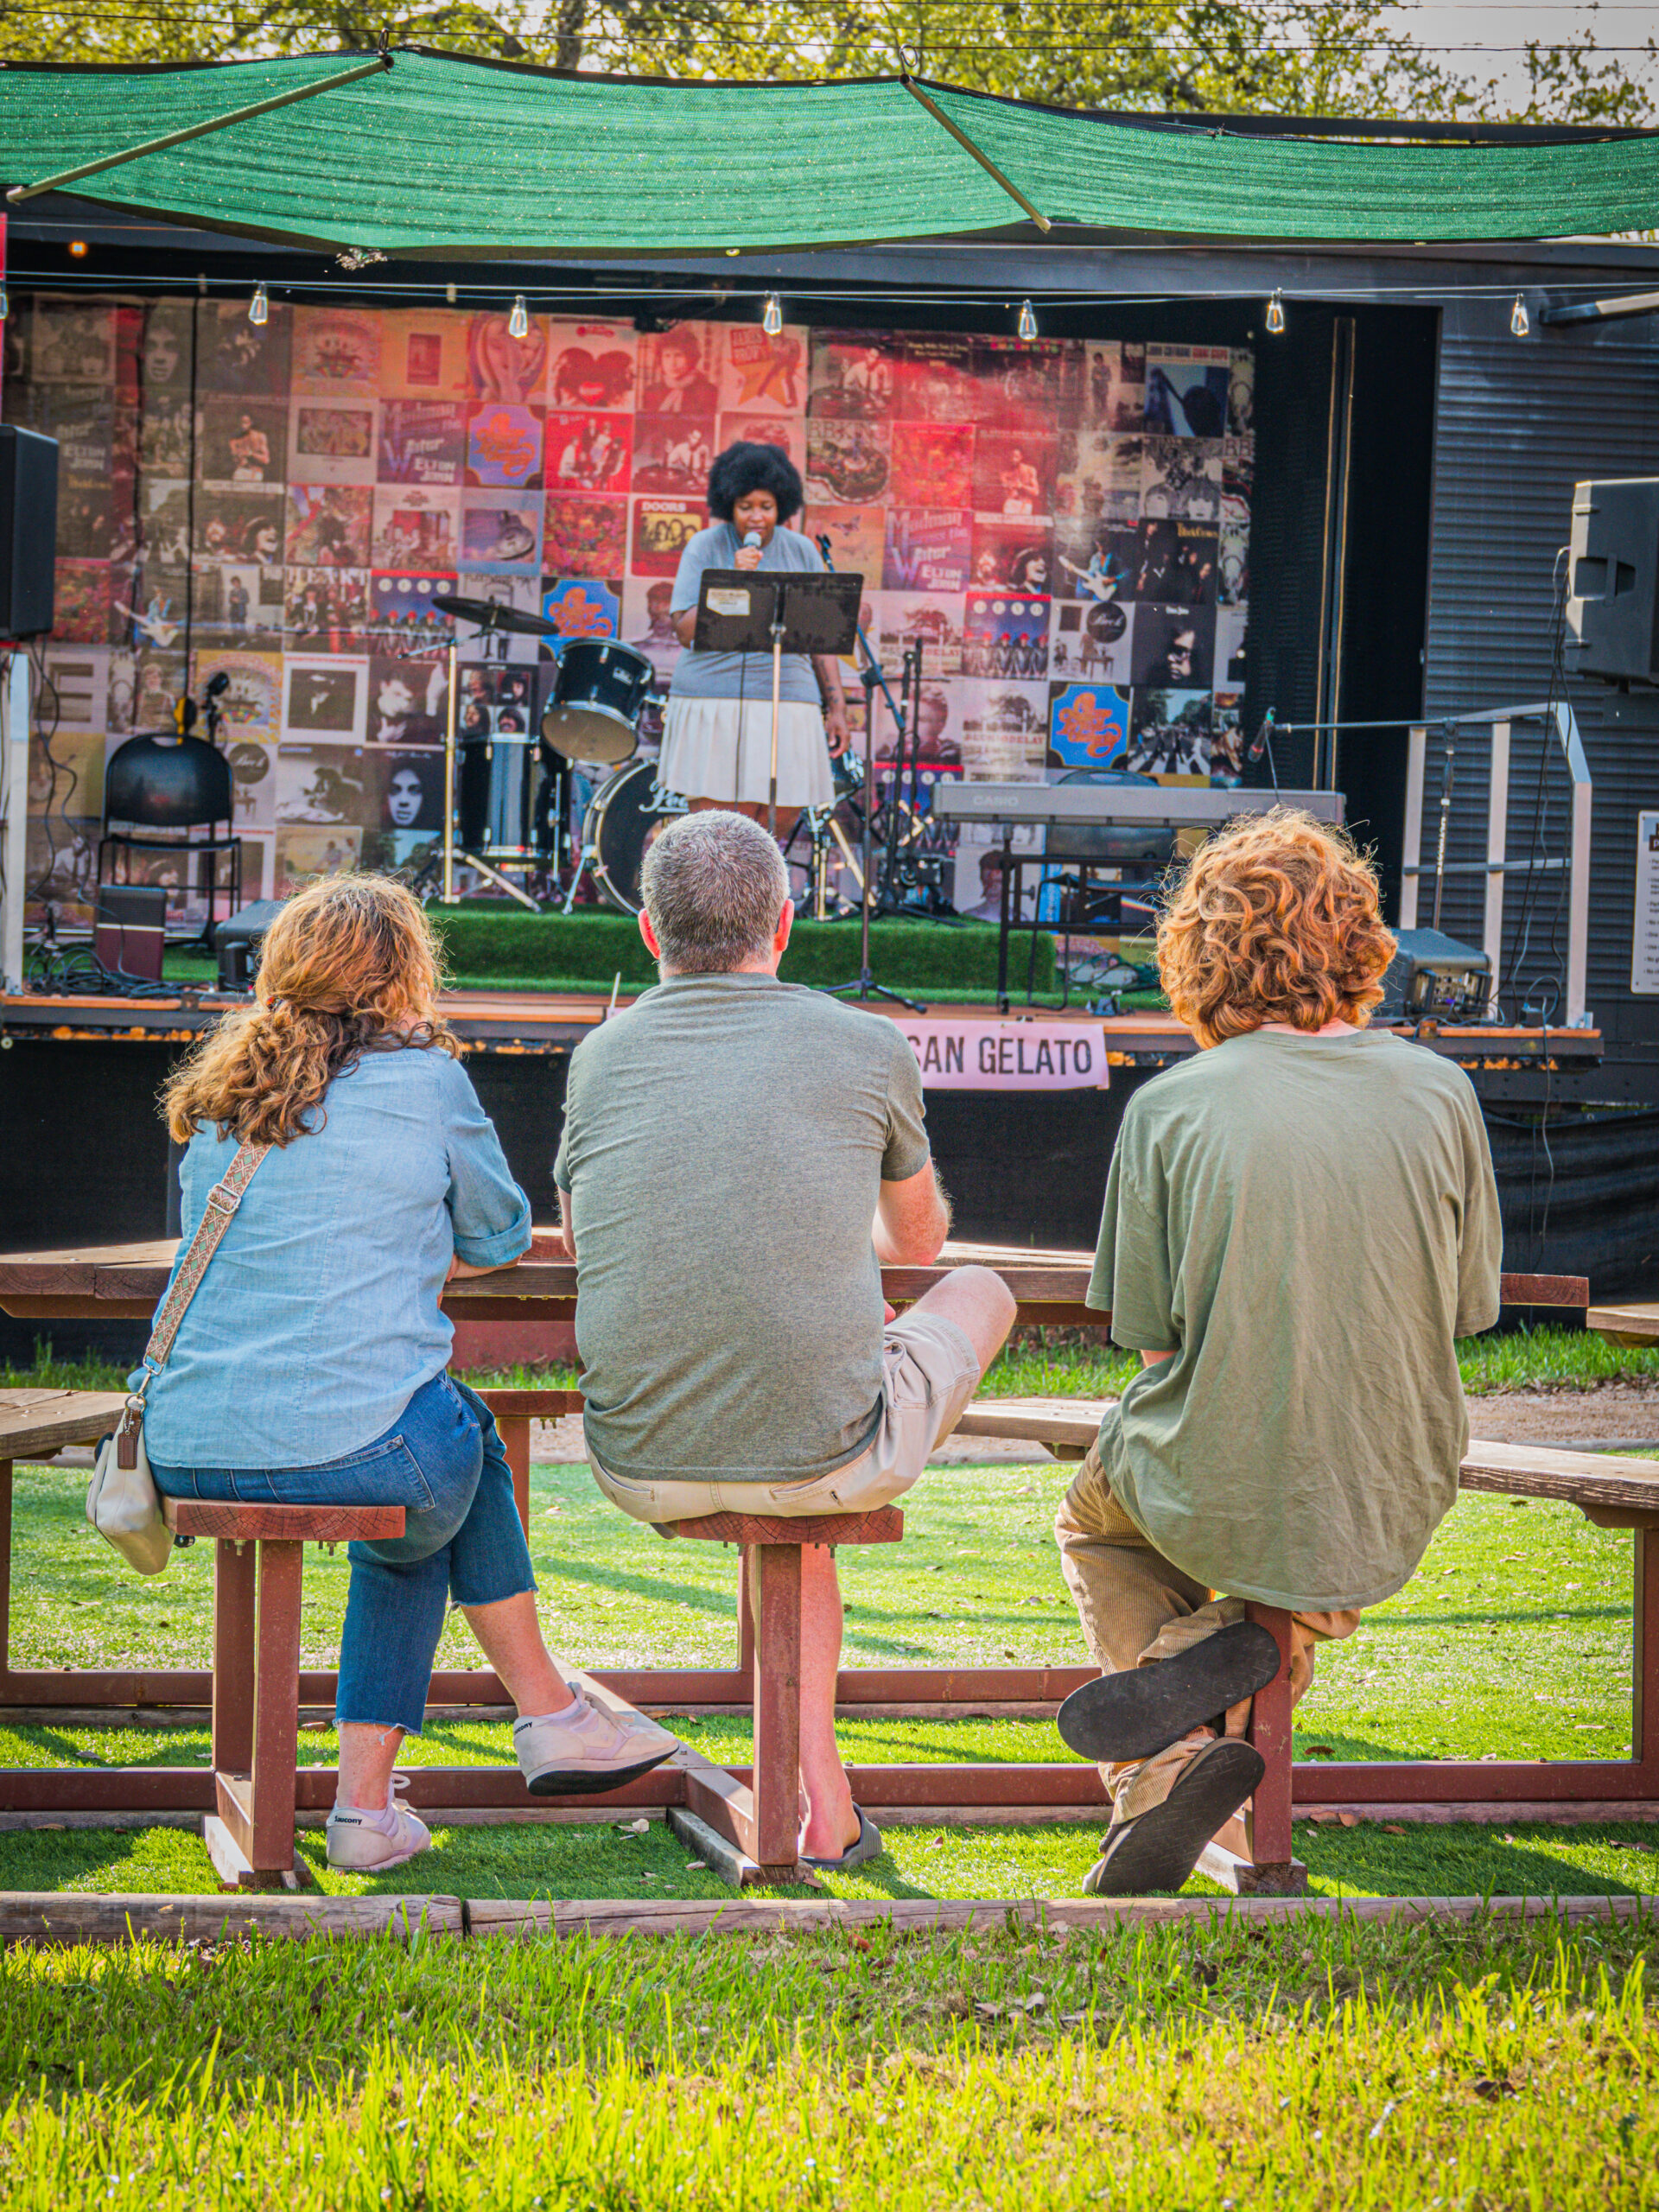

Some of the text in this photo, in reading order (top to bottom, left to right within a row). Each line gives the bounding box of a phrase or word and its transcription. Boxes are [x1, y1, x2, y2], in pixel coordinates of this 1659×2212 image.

[642, 500, 686, 512] DOORS
[974, 795, 1018, 808] CASIO
[978, 1036, 1093, 1076] GELATO
[334, 1815, 363, 1826] Saucony
